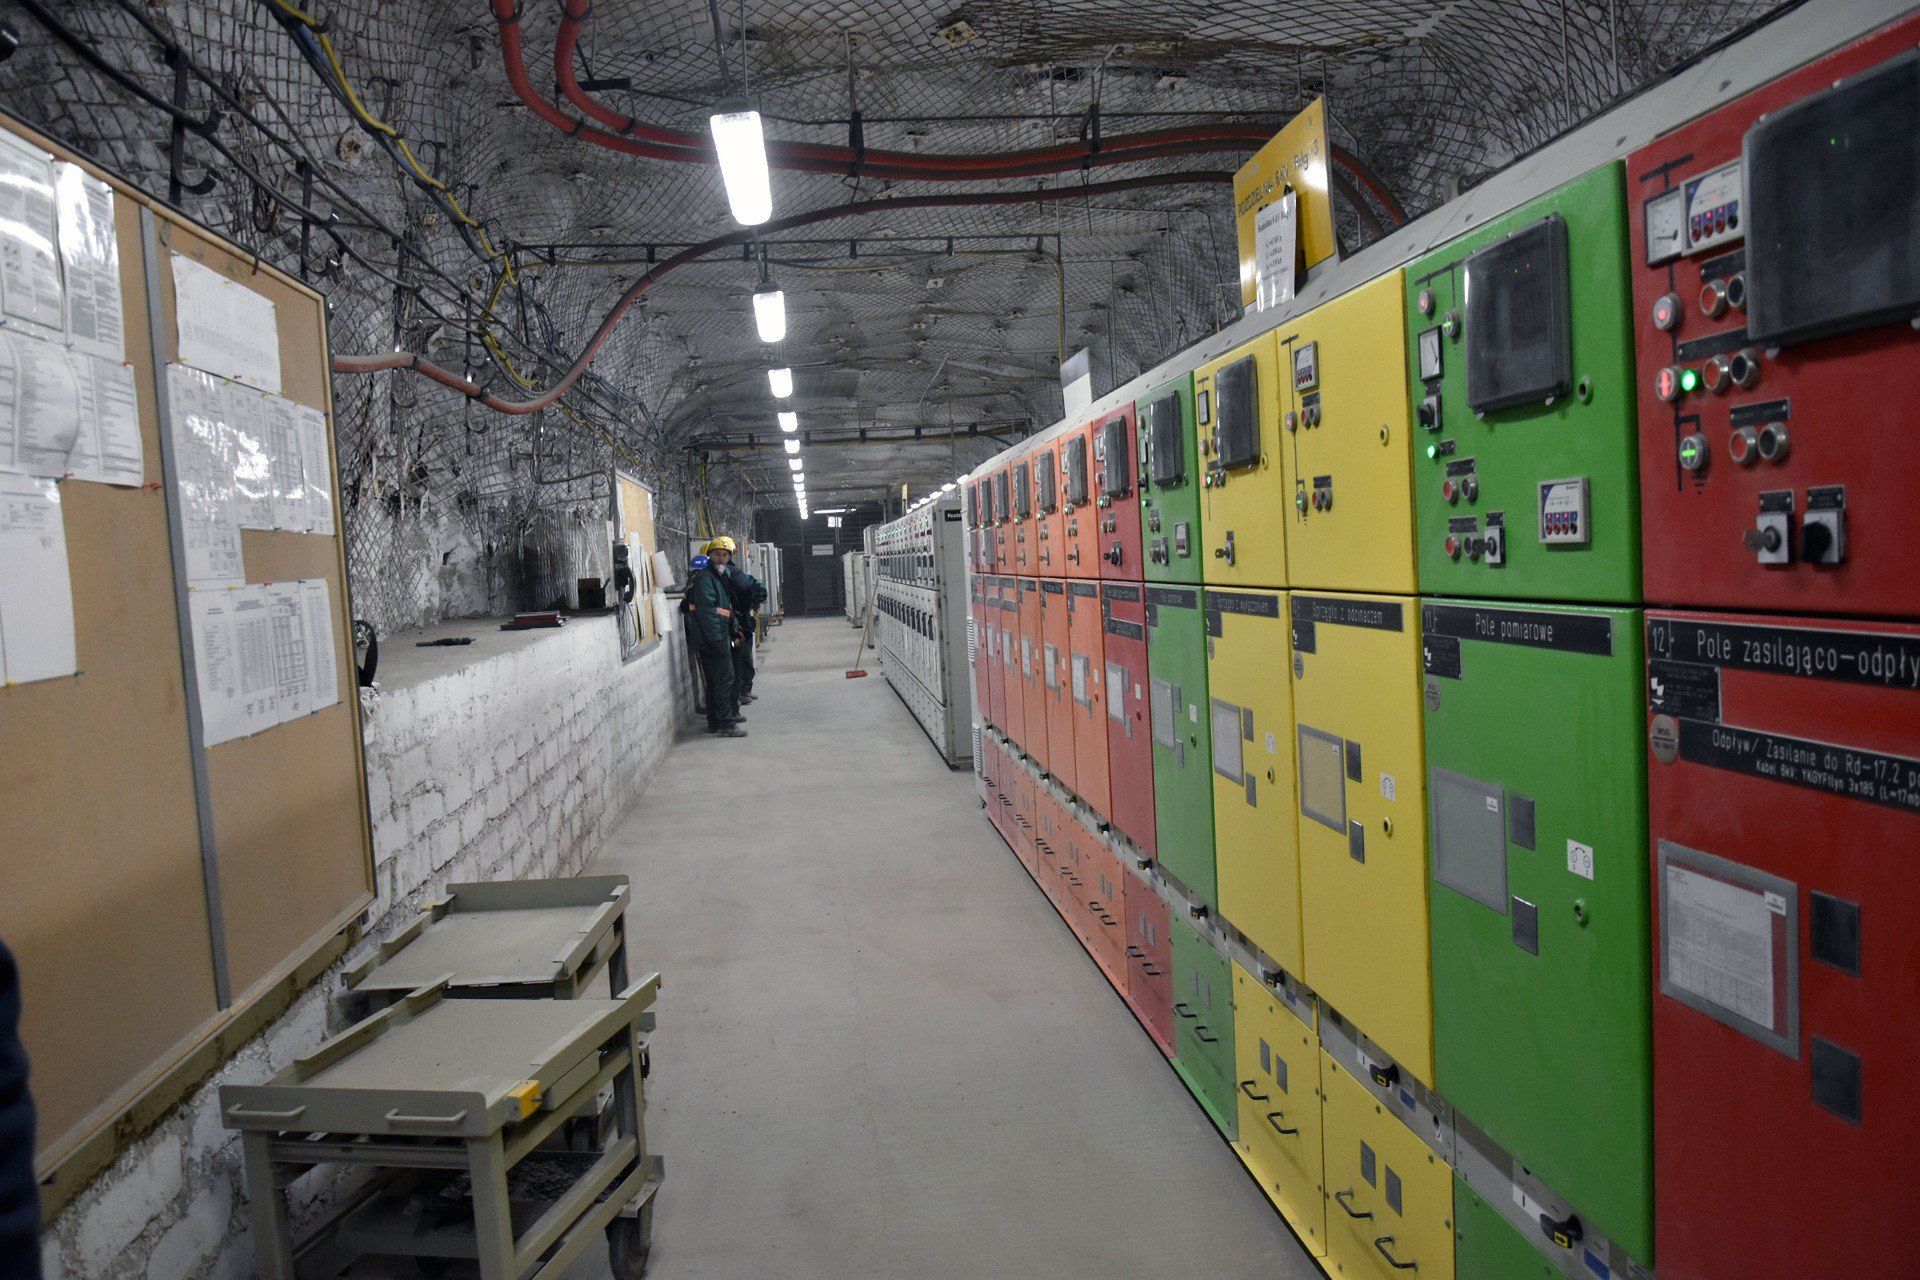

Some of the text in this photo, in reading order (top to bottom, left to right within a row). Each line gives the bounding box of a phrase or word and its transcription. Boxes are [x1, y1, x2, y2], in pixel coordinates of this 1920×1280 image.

[1474, 613, 1553, 643] Pole pomiarowe
[1697, 630, 1731, 660] Pole
[1756, 759, 1776, 775] Kabel
[1848, 778, 1875, 797] 3x185
[1766, 739, 1816, 765] Zasilanie
[1824, 751, 1838, 770] do
[1846, 754, 1899, 784] Rd-17.2
